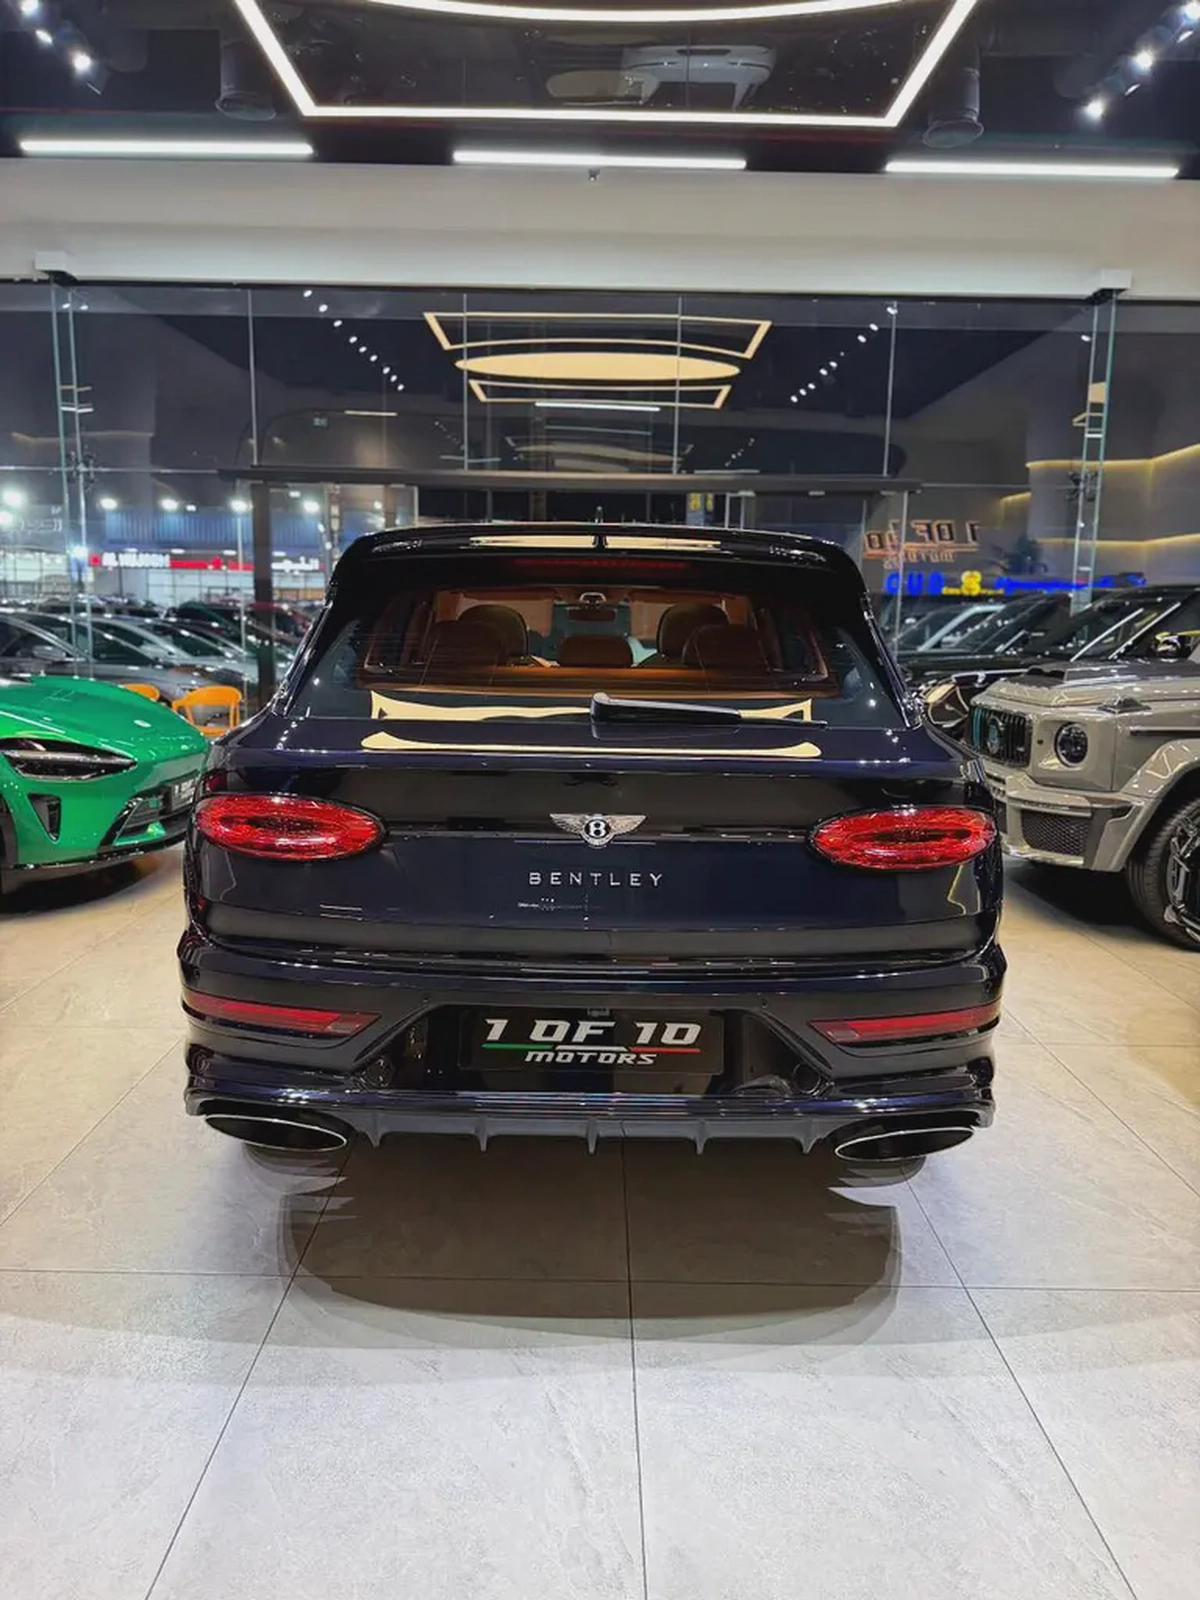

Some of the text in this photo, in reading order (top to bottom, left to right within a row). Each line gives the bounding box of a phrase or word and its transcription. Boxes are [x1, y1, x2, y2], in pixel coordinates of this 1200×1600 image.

[528, 871, 663, 887] BENTLEY
[484, 1018, 702, 1046] 1 OF 10
[524, 1050, 658, 1066] MOTORS
